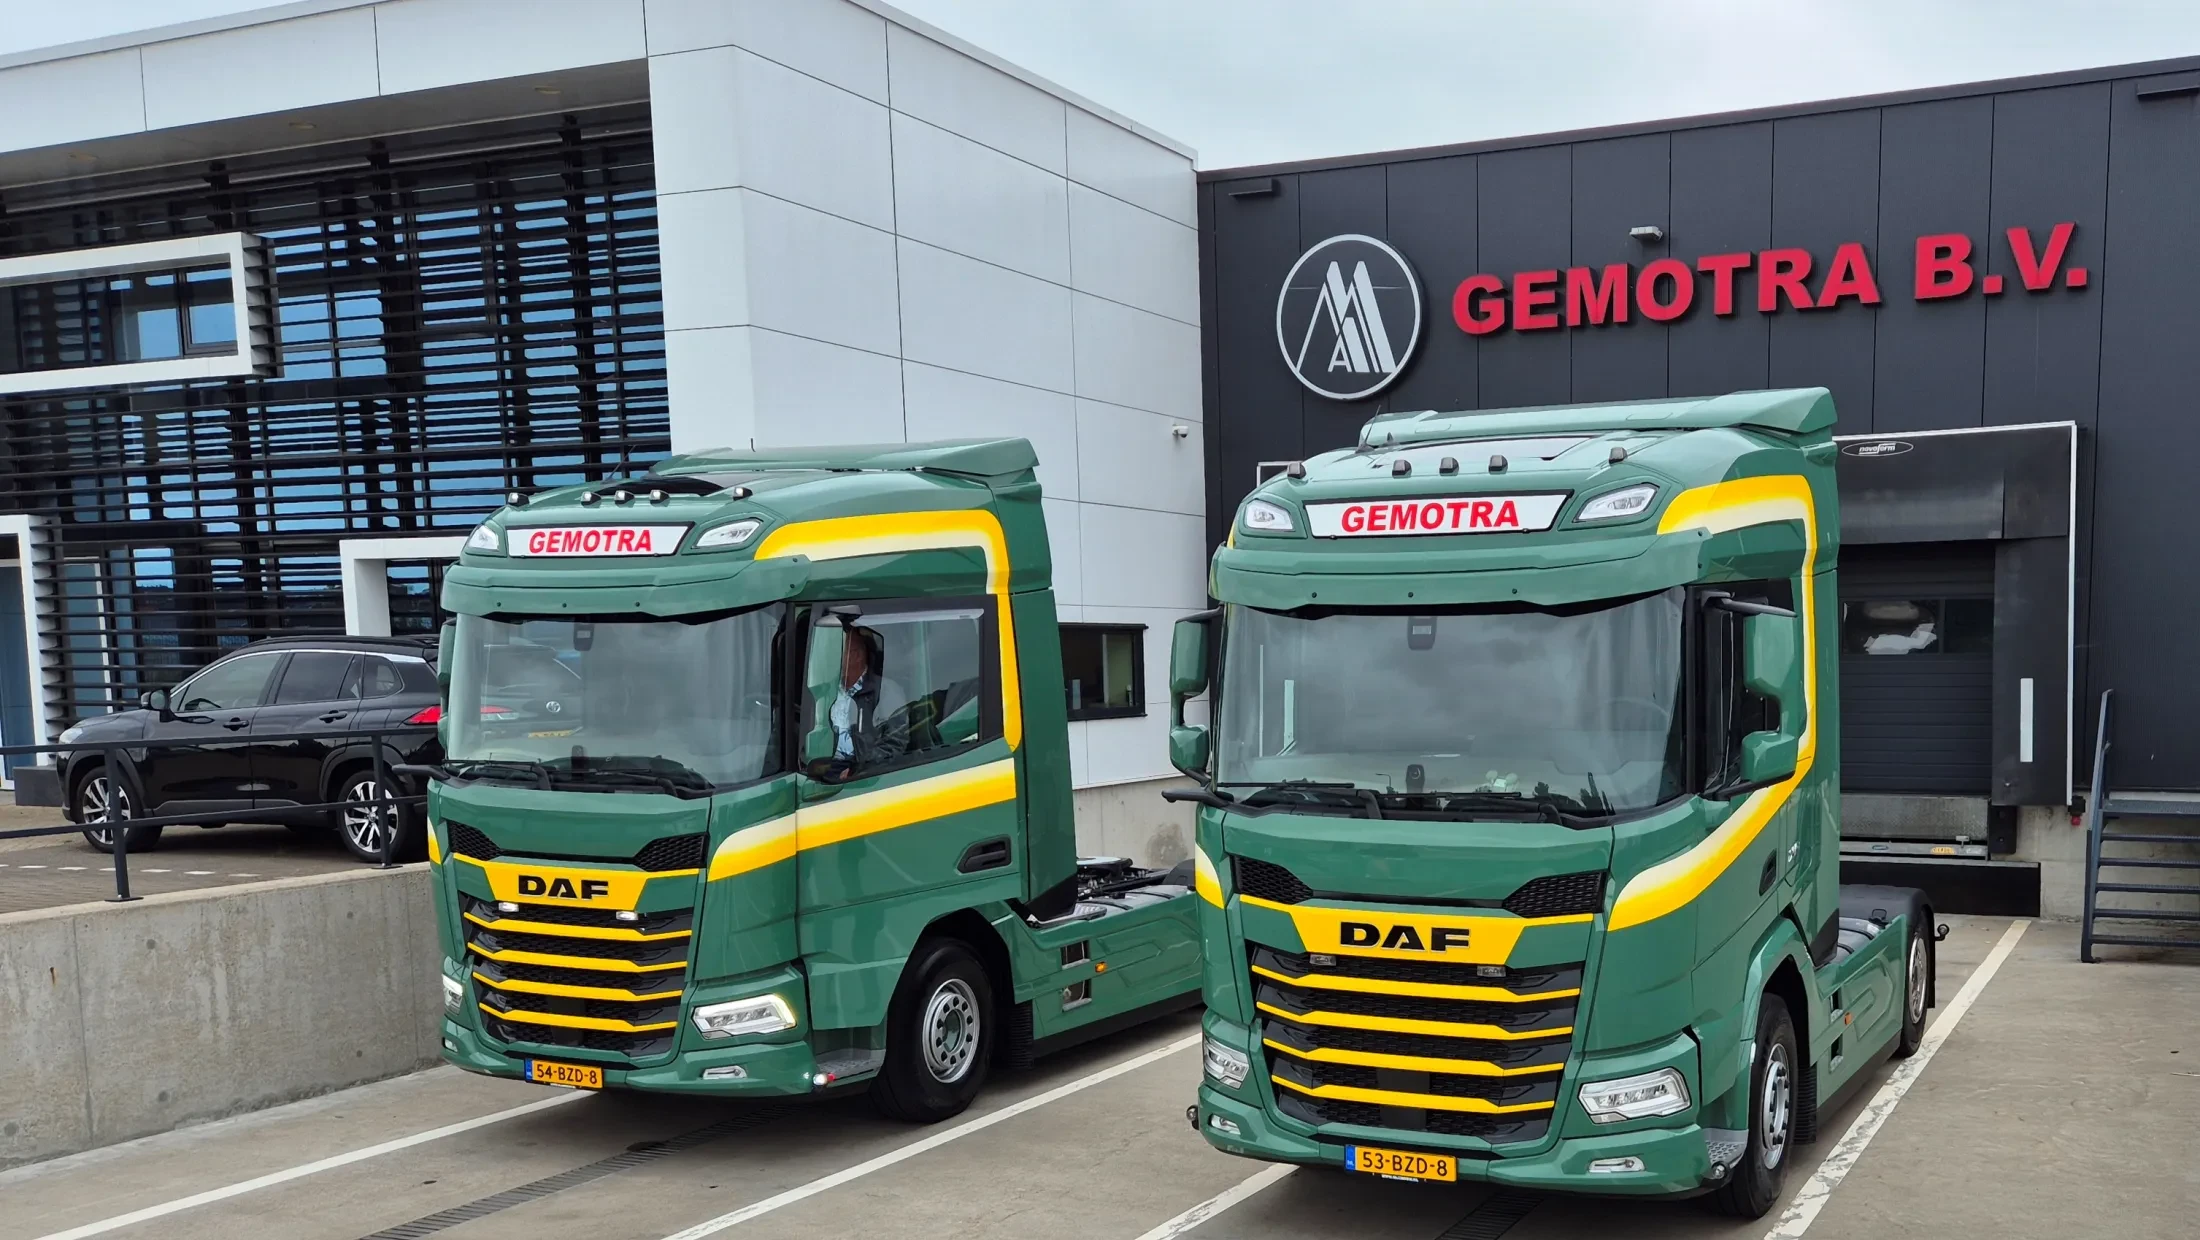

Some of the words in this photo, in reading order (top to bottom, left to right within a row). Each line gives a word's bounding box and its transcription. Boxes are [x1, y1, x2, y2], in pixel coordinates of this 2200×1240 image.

[1452, 242, 1881, 335] GEMOTRA
[1914, 221, 2088, 300] B.V.
[1341, 500, 1519, 532] GEMOTRA
[529, 529, 652, 553] GEMOTRA
[518, 875, 609, 900] DAF
[1340, 921, 1470, 953] DAF
[536, 1063, 598, 1085] 54-BZD-8
[1363, 1151, 1448, 1177] 53-BZD-8
